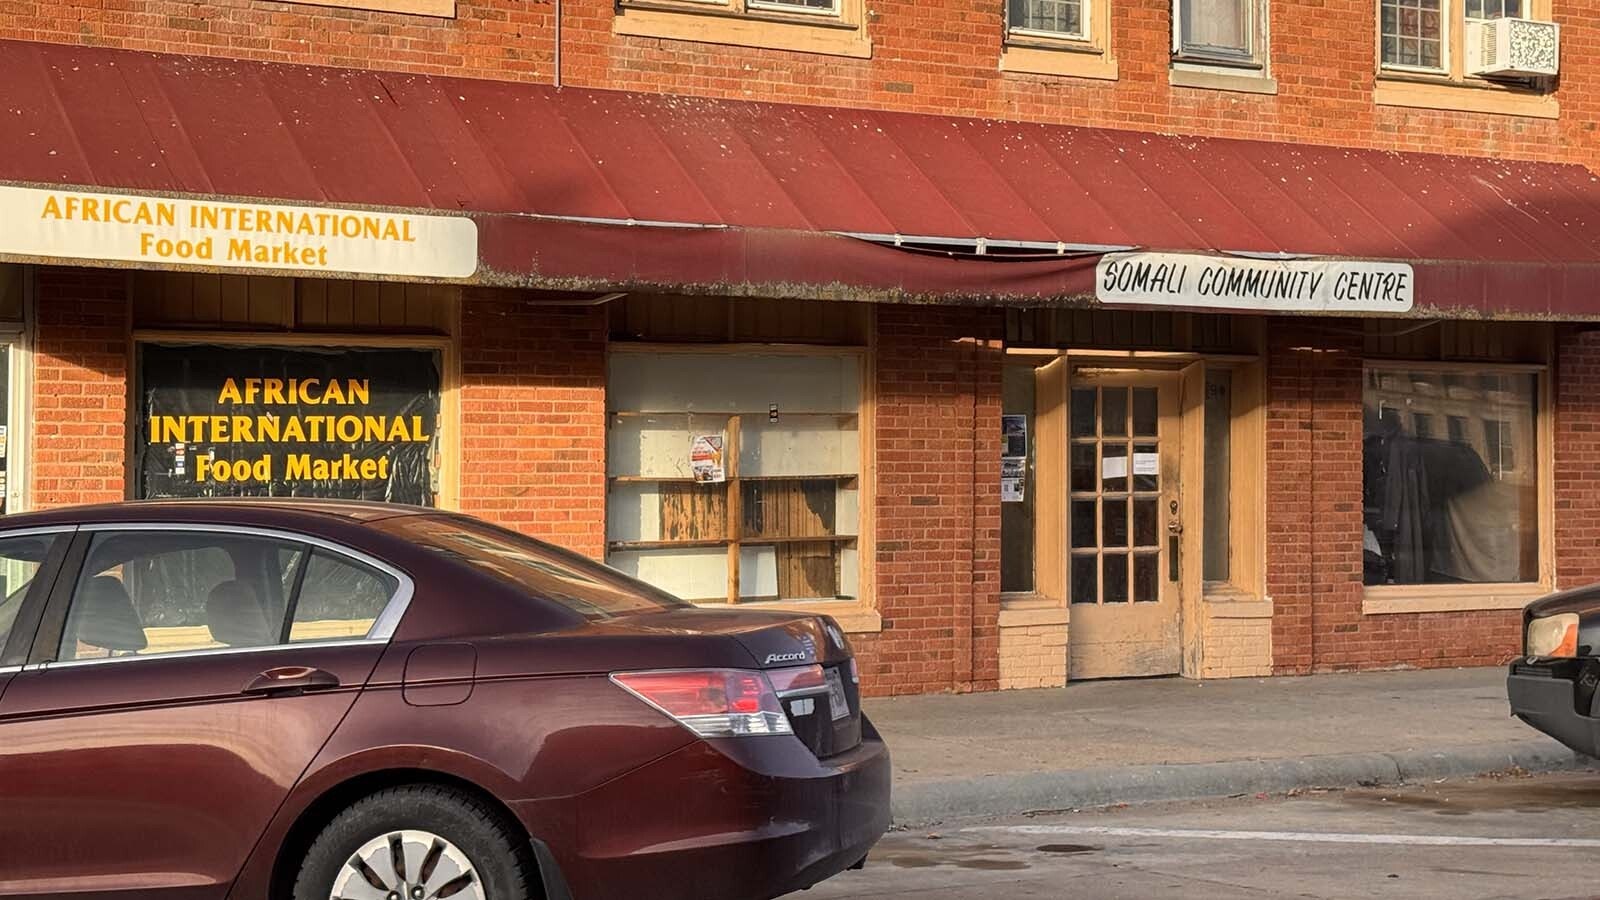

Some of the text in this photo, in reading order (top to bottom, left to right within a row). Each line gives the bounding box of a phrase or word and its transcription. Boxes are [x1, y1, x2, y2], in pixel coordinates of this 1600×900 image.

[42, 196, 415, 242] AFRICAN INTERNATIONAL
[141, 233, 327, 266] Food Market
[1104, 261, 1408, 302] SOMALI COMMUNITY CENTRE
[218, 378, 369, 405] AFRICAN
[150, 415, 429, 443] INTERNATIONAL
[196, 455, 271, 482] Food
[285, 454, 389, 481] Market
[765, 651, 806, 664] Accord
